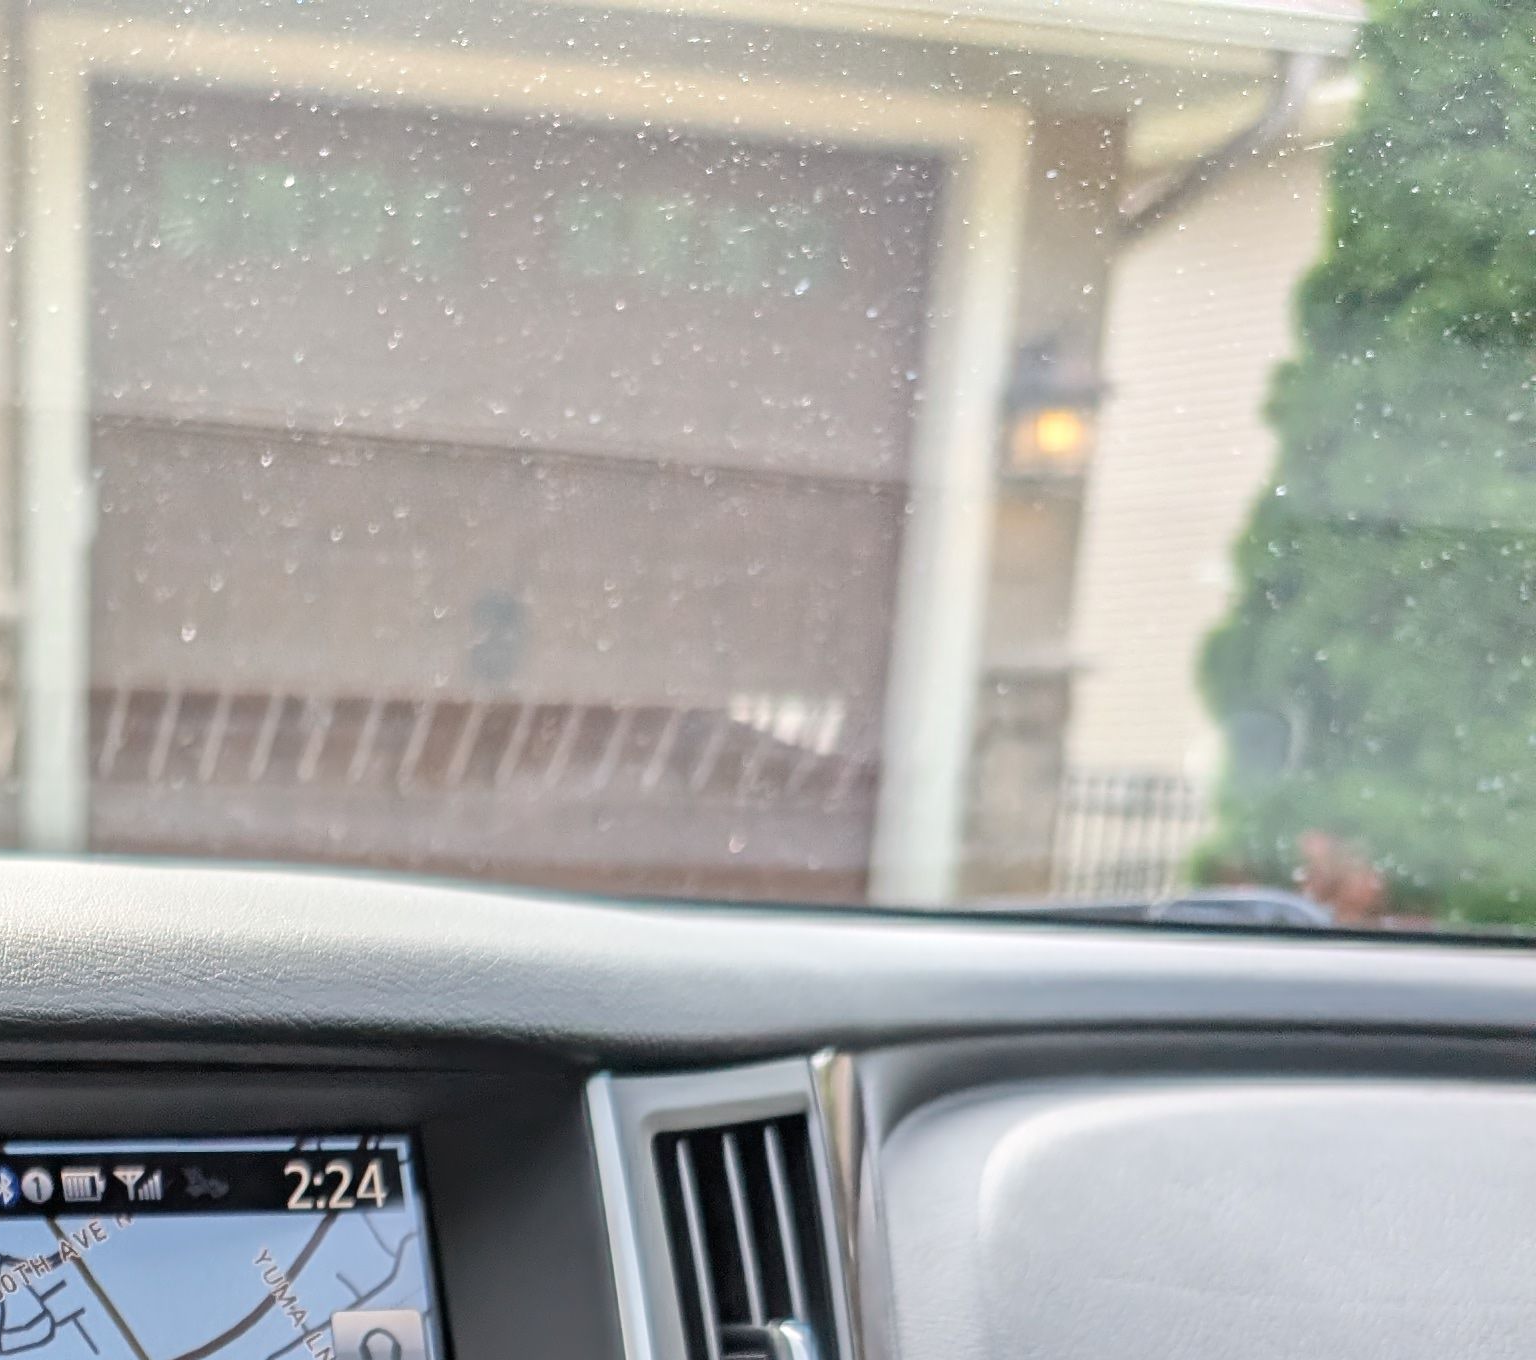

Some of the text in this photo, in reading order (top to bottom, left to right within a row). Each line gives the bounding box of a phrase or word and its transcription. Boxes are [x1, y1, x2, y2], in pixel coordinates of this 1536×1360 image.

[282, 1158, 388, 1211] 2:24
[58, 1220, 108, 1262] AVE
[254, 1248, 308, 1328] YUMA
